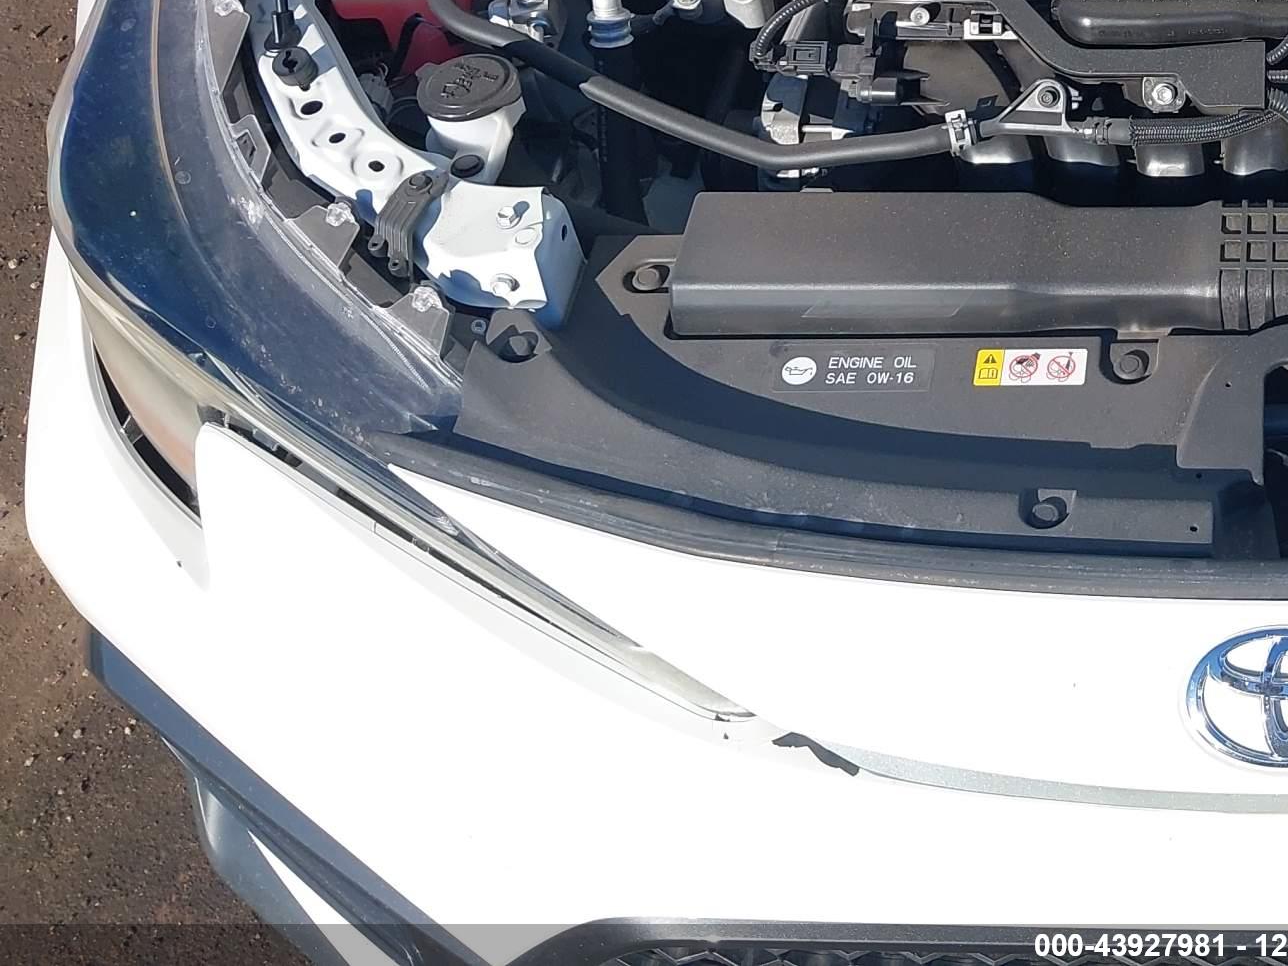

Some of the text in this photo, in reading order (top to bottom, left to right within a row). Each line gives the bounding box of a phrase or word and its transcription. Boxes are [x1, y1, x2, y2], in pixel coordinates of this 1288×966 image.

[828, 356, 917, 369] ENGINE OIL
[825, 371, 914, 384] SAE 0W-16
